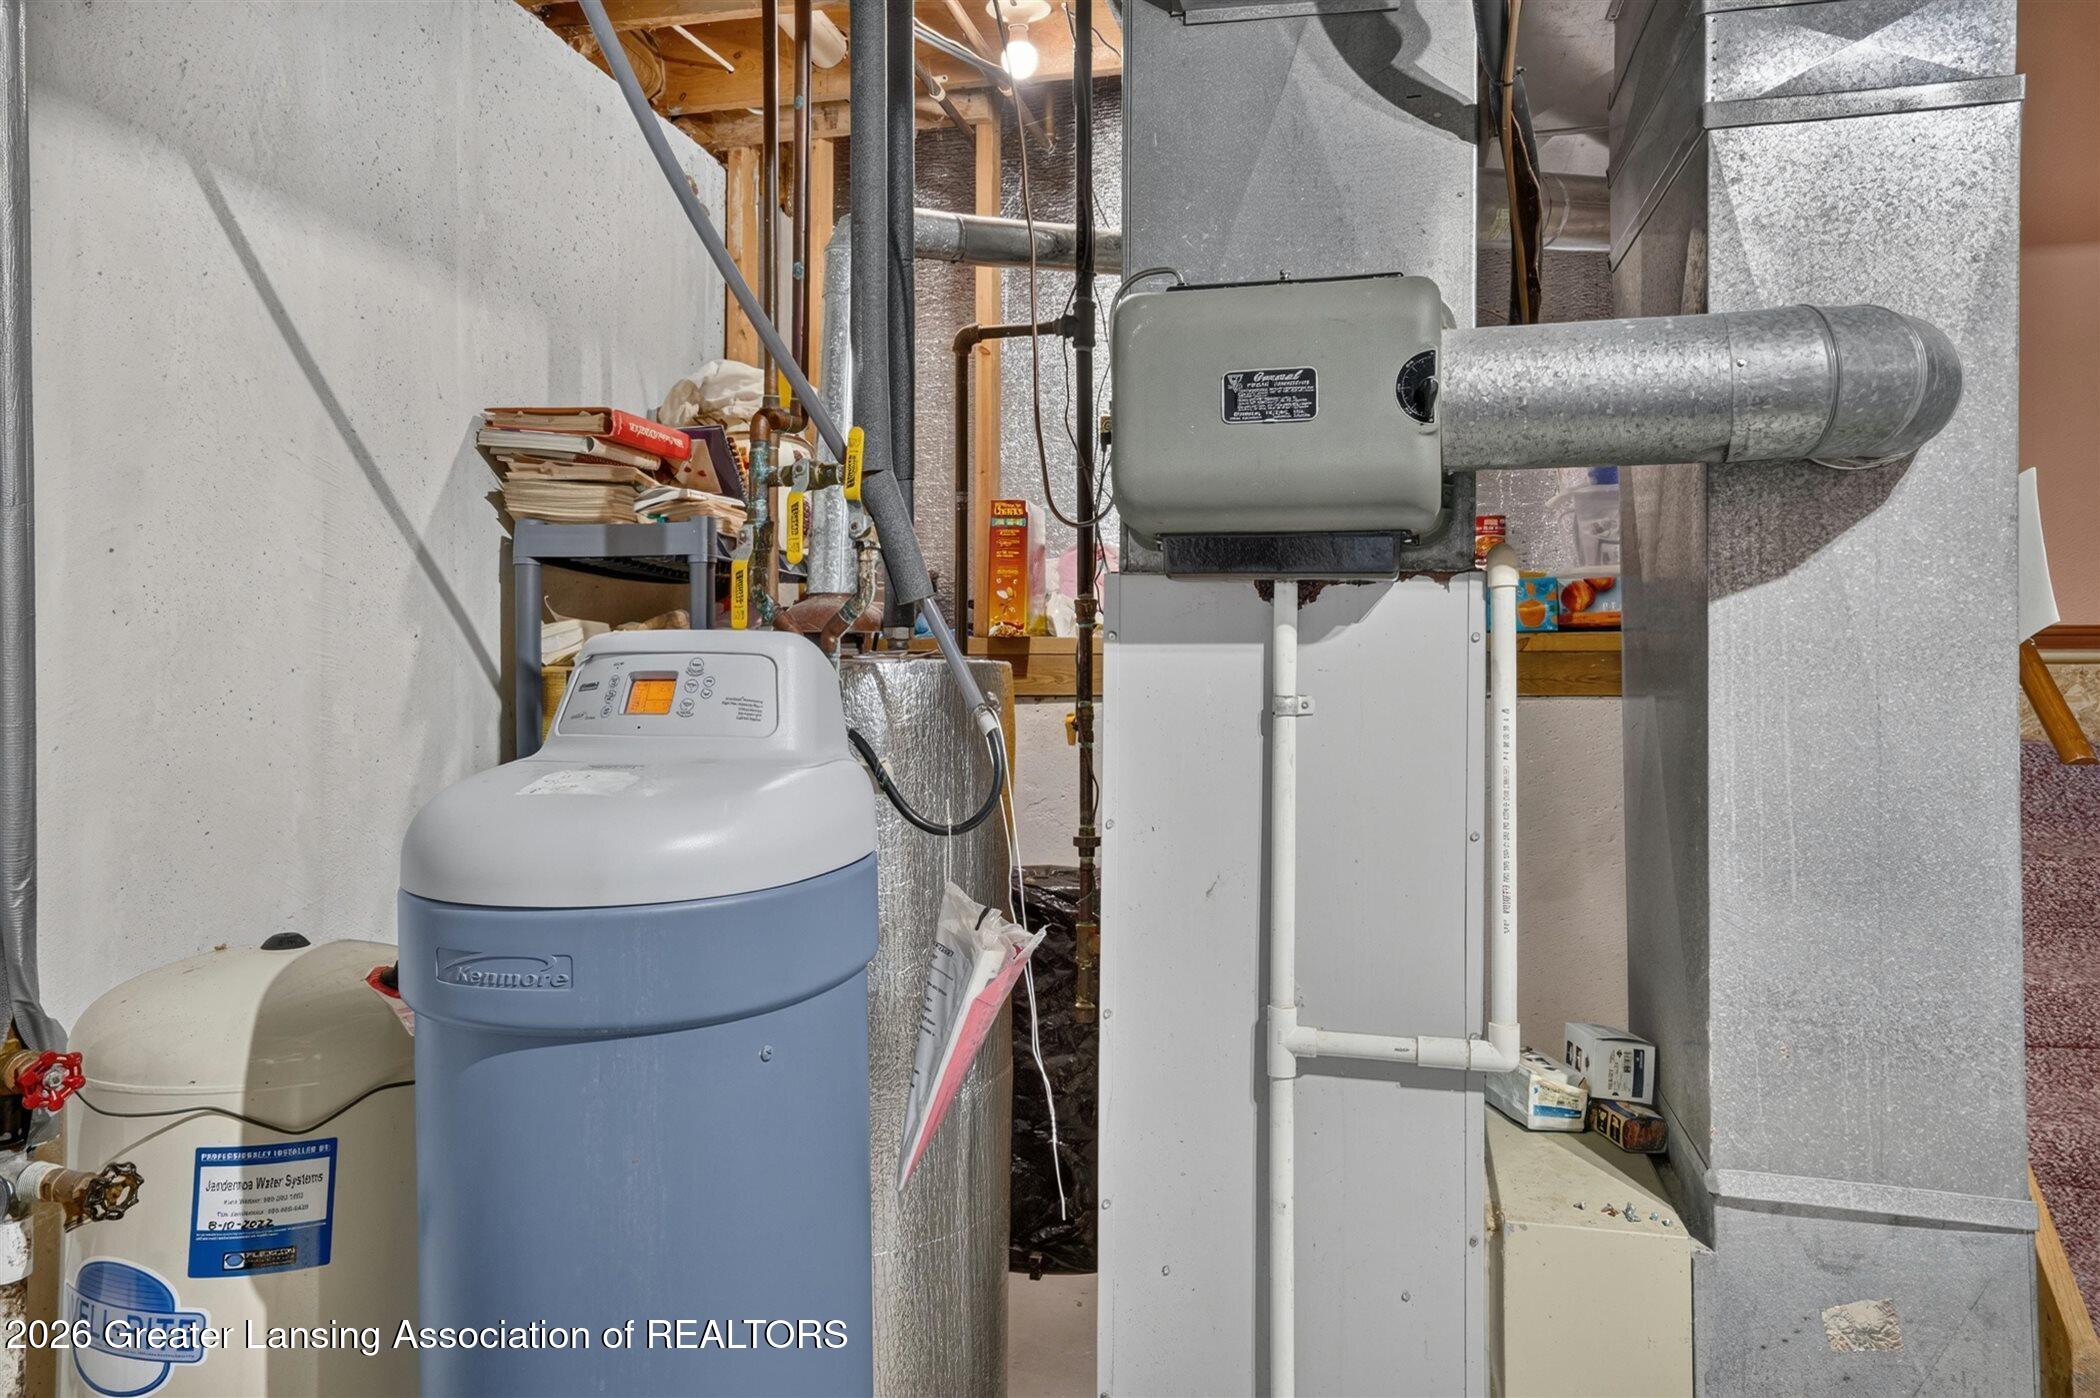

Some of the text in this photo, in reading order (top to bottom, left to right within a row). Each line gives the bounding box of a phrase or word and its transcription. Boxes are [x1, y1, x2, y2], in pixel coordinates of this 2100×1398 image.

[256, 1175, 282, 1189] Water
[285, 1173, 323, 1189] Systems
[208, 1218, 274, 1231] 8-10-2022
